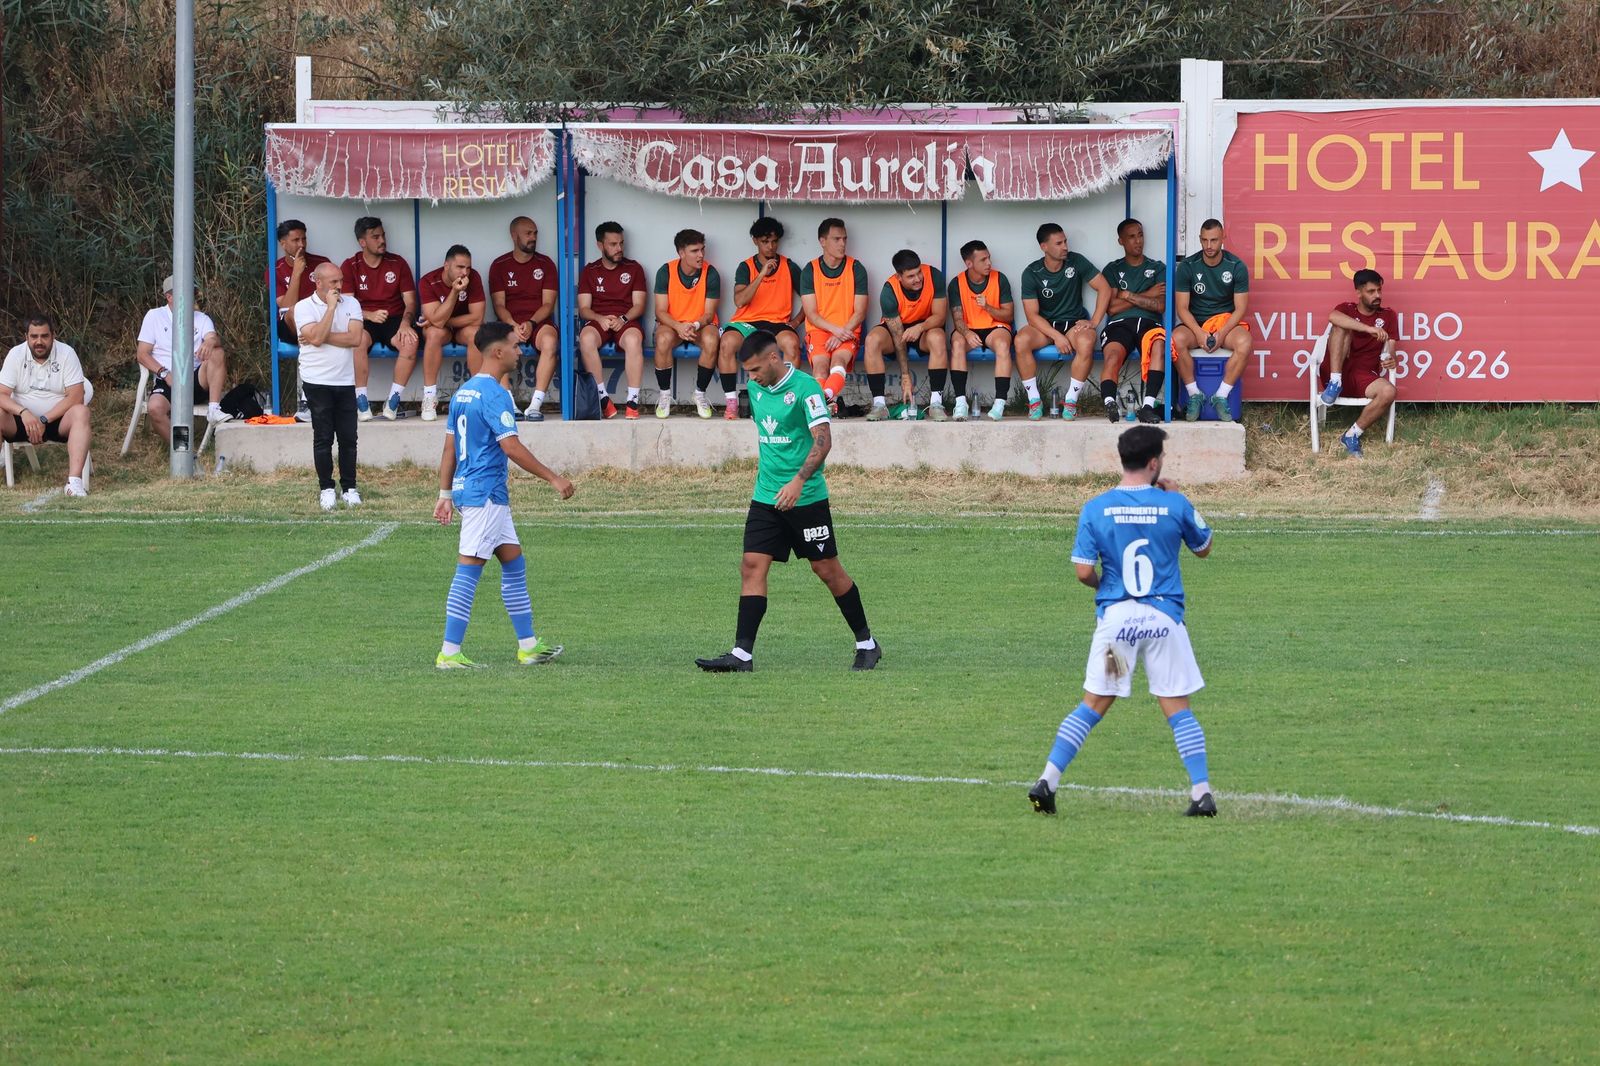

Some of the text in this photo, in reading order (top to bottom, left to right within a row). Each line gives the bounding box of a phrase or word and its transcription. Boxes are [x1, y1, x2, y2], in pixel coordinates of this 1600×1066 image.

[443, 144, 521, 167] HOTEL
[636, 140, 779, 192] Casa
[1254, 132, 1480, 191] HOTEL
[443, 177, 520, 199] RESTA
[1254, 311, 1463, 341] VILLLBO
[1254, 350, 1278, 379] T.
[1446, 349, 1510, 380] 626
[1122, 538, 1154, 597] 6
[1116, 626, 1169, 647] Alfonso
